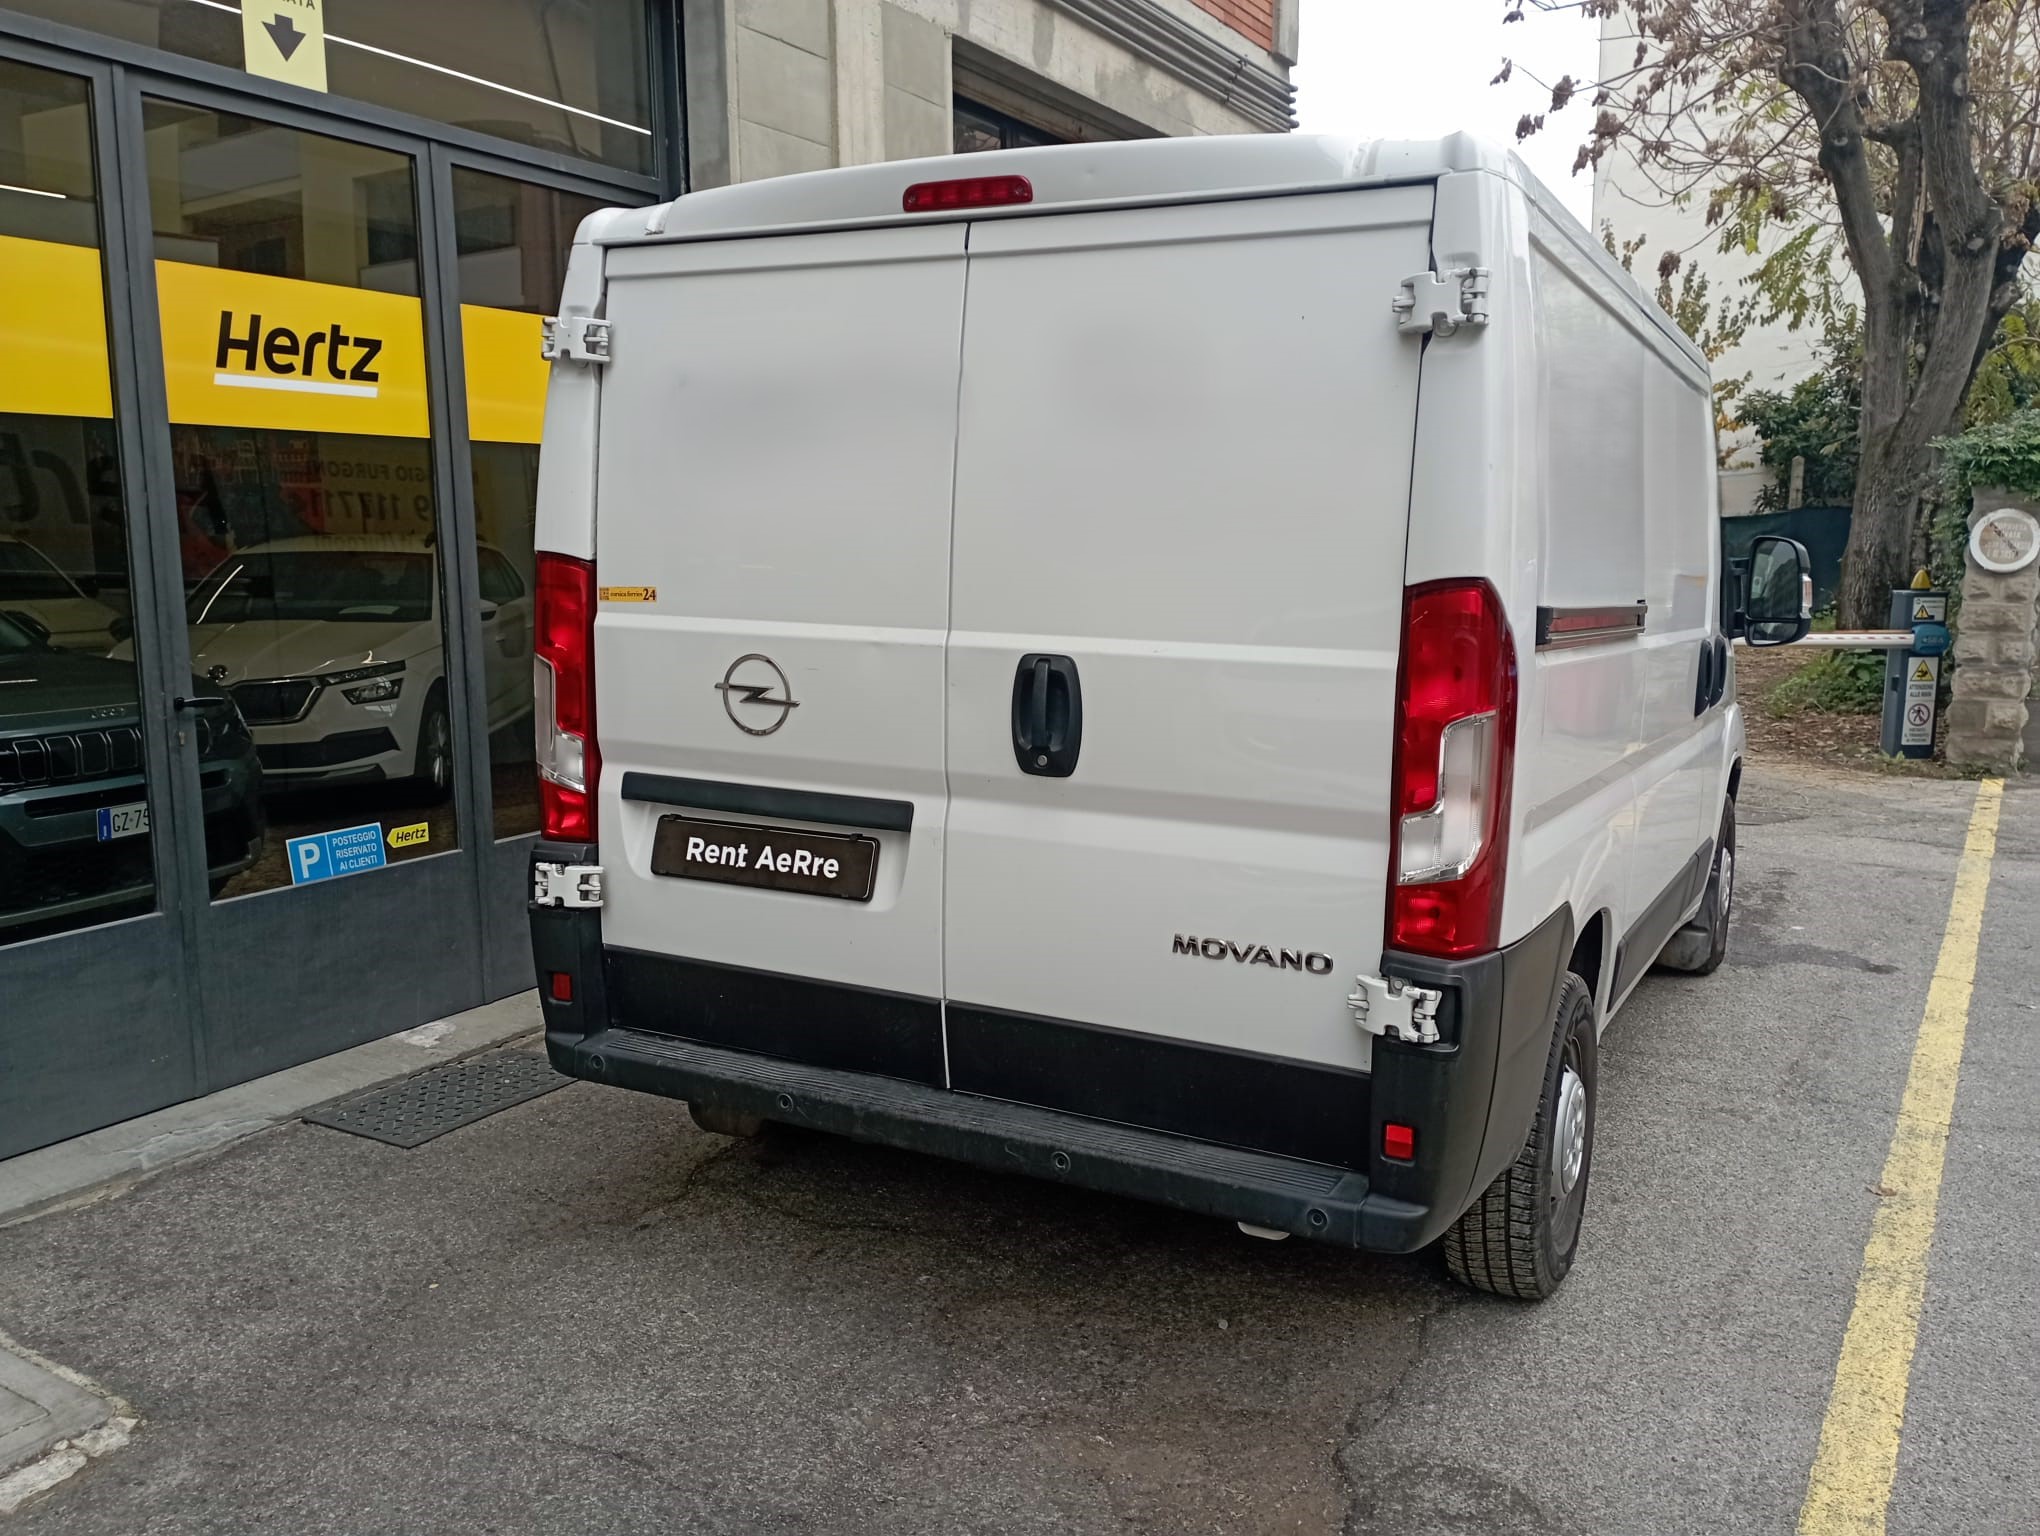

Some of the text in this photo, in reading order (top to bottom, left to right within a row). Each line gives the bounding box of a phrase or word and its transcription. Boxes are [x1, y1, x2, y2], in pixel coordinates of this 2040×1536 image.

[215, 310, 382, 382] Hertz
[643, 588, 656, 601] 24
[332, 830, 376, 847] POSTEGGIO
[396, 828, 426, 843] Hertz
[336, 843, 377, 859] RISERVATO
[685, 836, 840, 878] Rent AeRre
[298, 842, 321, 879] P
[340, 855, 378, 871] AI CLIENTI
[1172, 933, 1333, 975] MOVANO
